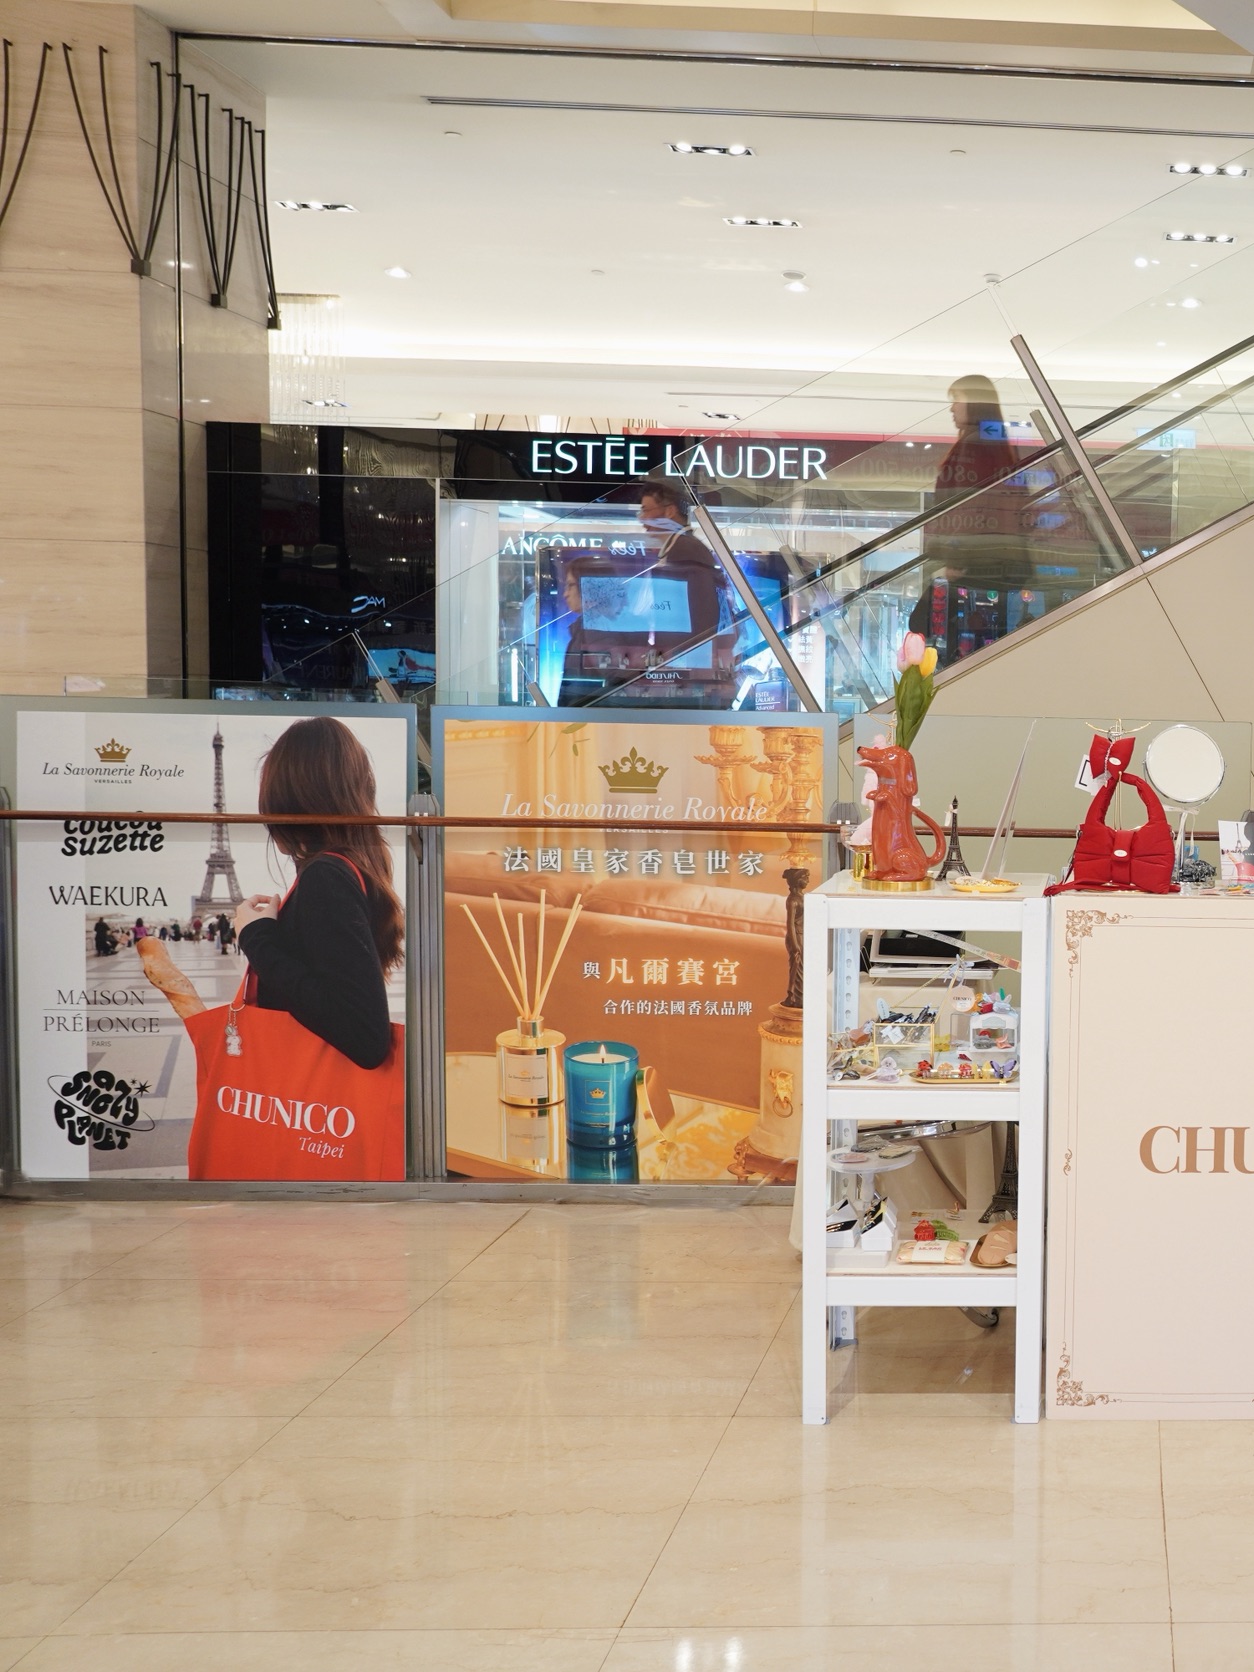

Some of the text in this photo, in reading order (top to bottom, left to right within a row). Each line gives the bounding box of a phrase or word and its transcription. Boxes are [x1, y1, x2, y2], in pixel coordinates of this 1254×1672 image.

[666, 443, 828, 480] LAUDER
[42, 762, 185, 780] La Savonnerie Royale
[501, 793, 768, 823] La Savonnerie Royale
[61, 830, 165, 857] suzette
[503, 846, 764, 876] 法國皇家香皂世家
[49, 885, 168, 908] WAEKURA
[56, 988, 146, 1007] MAISON
[603, 999, 753, 1016] 合作的法國香氛品牌
[42, 1012, 160, 1034] PRÉLONGE
[91, 1040, 112, 1048] PARIS
[216, 1085, 356, 1139] CHUNICO
[54, 1100, 131, 1150] PLANET
[298, 1136, 346, 1160] Taipei
